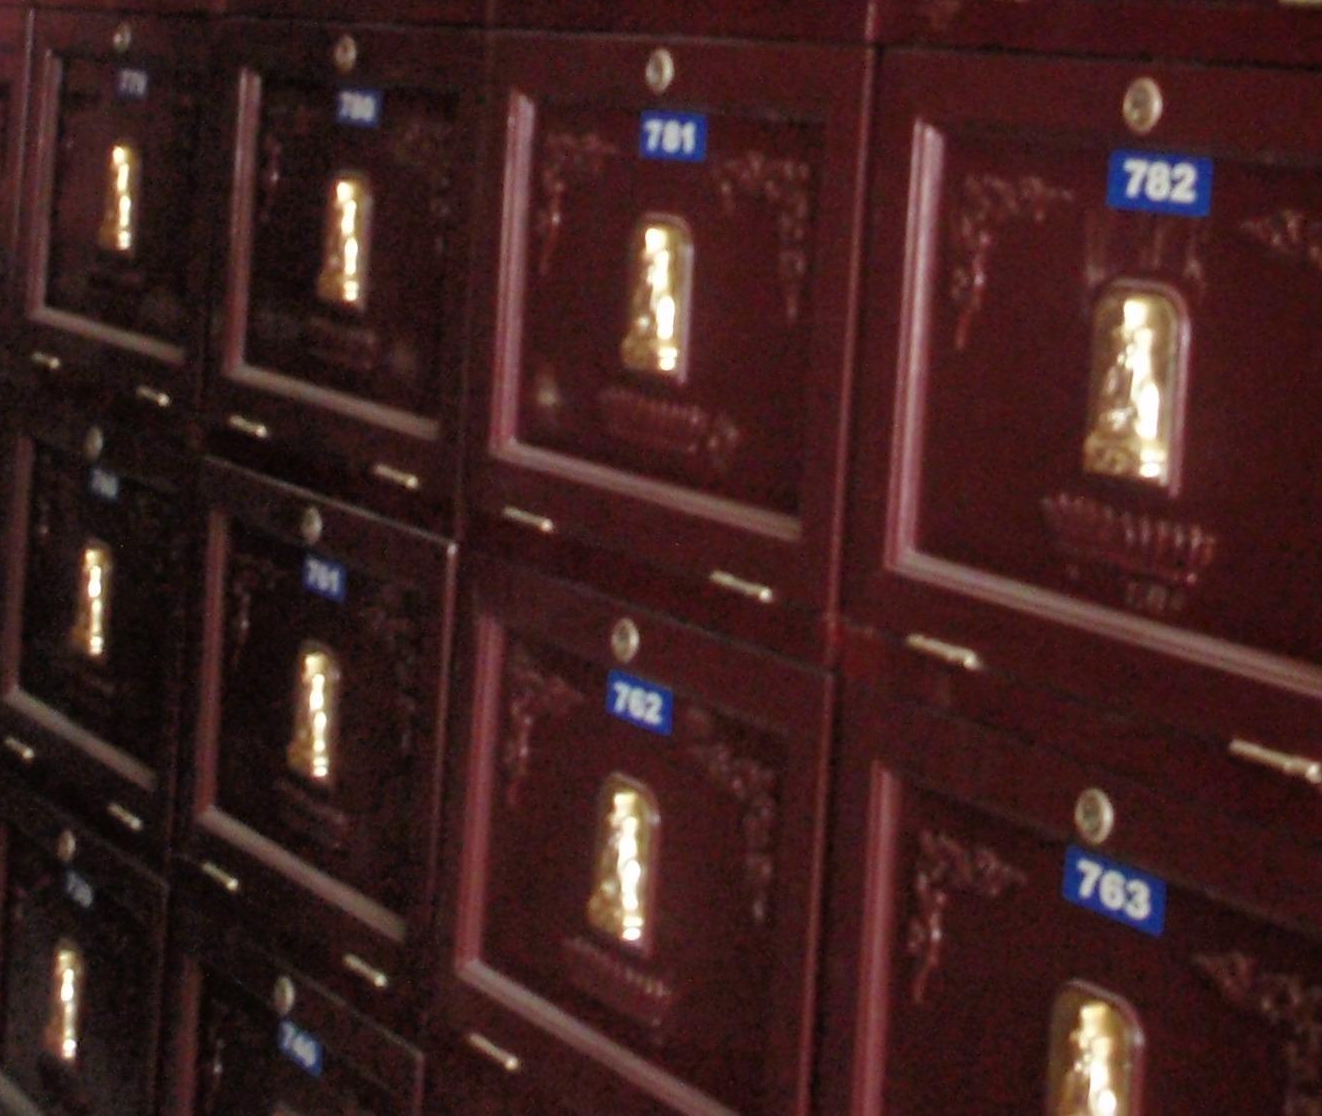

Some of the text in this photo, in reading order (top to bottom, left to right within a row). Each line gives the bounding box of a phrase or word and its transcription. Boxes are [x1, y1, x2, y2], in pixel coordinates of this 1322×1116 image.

[642, 117, 696, 154] 781
[1122, 158, 1198, 205] 782
[611, 678, 663, 726] 762
[1077, 858, 1152, 922] 763
